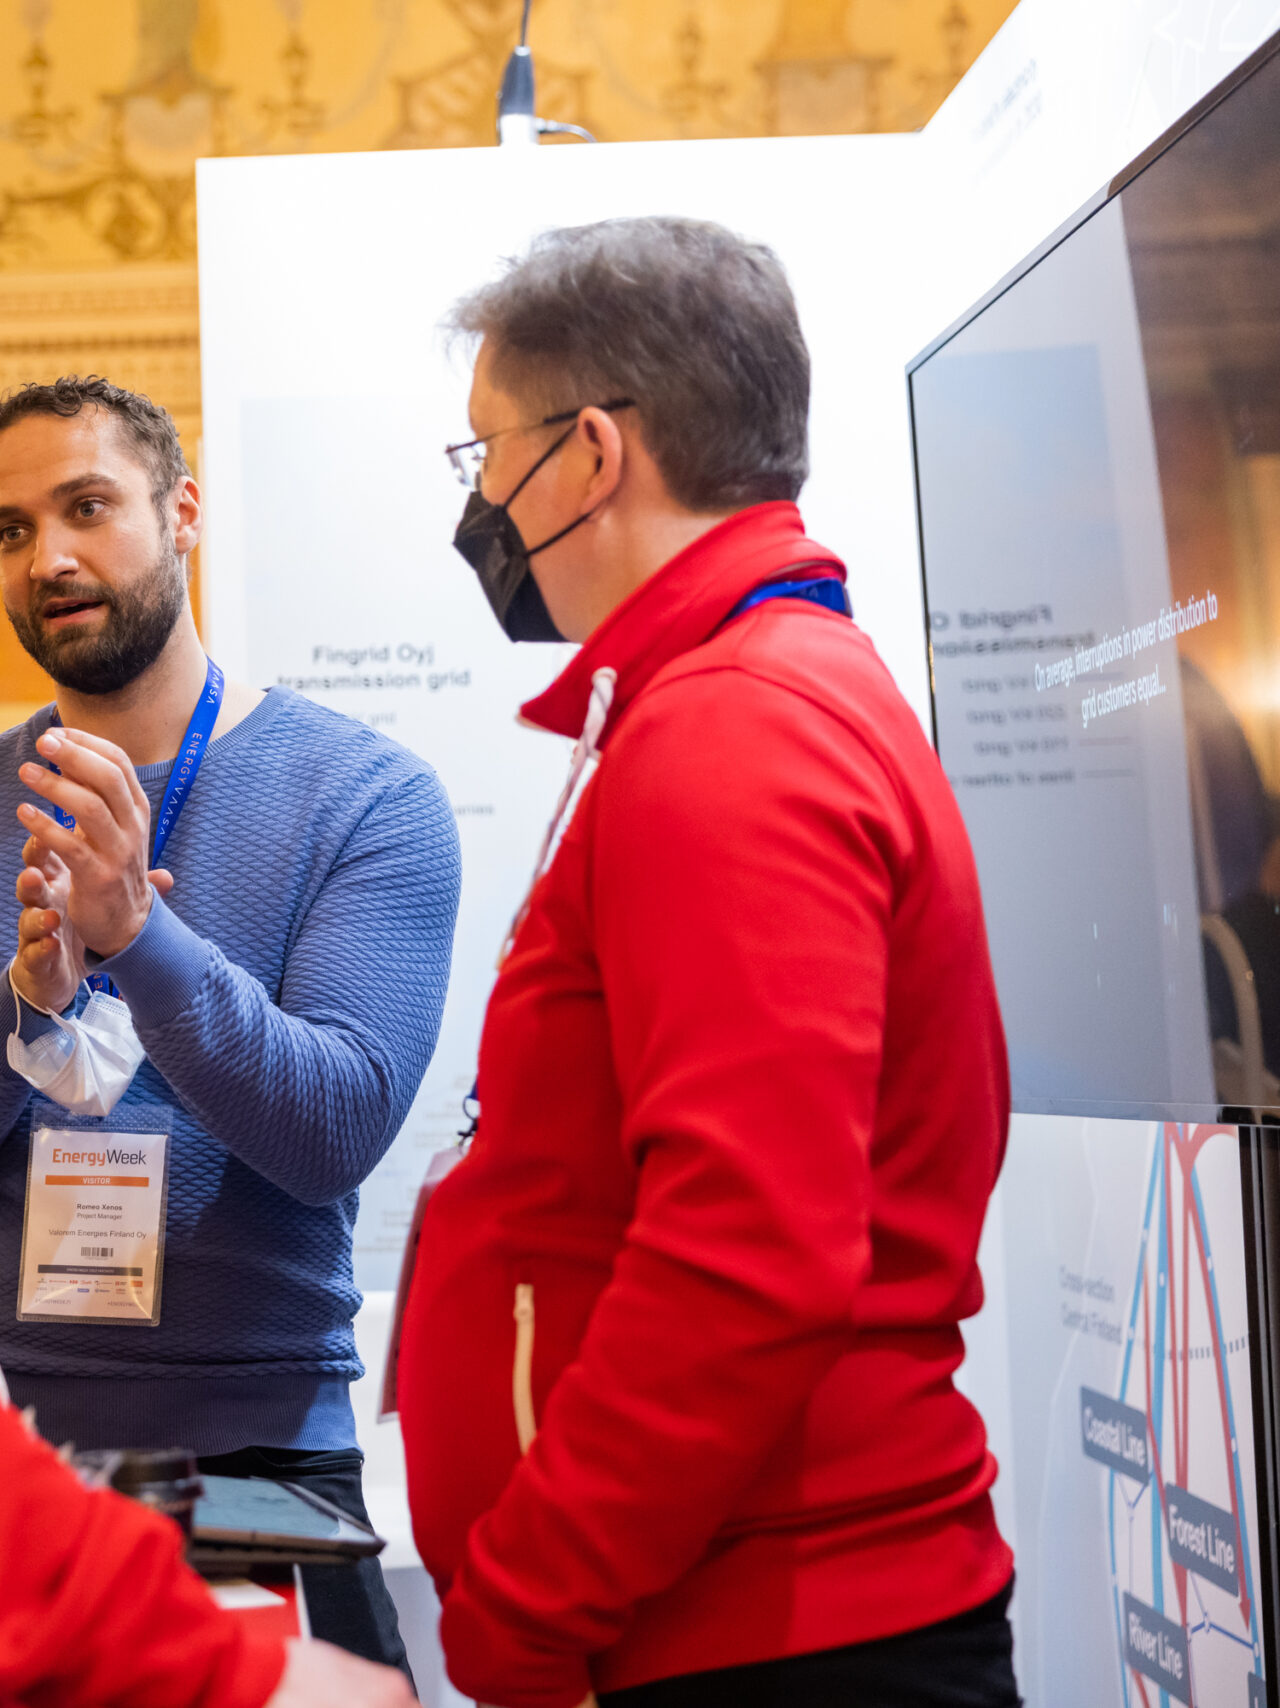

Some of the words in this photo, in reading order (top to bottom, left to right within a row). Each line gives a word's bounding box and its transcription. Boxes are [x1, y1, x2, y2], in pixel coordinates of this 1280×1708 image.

[1034, 663, 1046, 692] On
[1046, 656, 1076, 689] average,
[1075, 632, 1123, 675] interruptions
[1122, 625, 1132, 655] in
[1132, 620, 1157, 661] power
[1157, 594, 1207, 641] distribution
[1206, 589, 1218, 621] to
[312, 645, 389, 666] Fingrid
[396, 643, 435, 666] Oyj
[277, 673, 421, 691] transmission
[428, 669, 471, 692] grid
[1081, 688, 1097, 728] grid
[1097, 683, 1137, 717] customers
[52, 1148, 147, 1167] EnergyWeek
[82, 1177, 111, 1185] VISITOR
[76, 1212, 97, 1220] Project
[97, 1213, 123, 1221] Manager
[48, 1228, 76, 1236] Valorem
[77, 1229, 108, 1238] Energies
[110, 1230, 135, 1238] Finland
[136, 1231, 147, 1240] Oy
[1084, 1406, 1121, 1456] Coastal
[1121, 1422, 1146, 1467] Line
[1169, 1504, 1207, 1559] Forest
[1207, 1523, 1235, 1574] Line
[1128, 1611, 1157, 1663] River
[1157, 1631, 1184, 1681] Line
